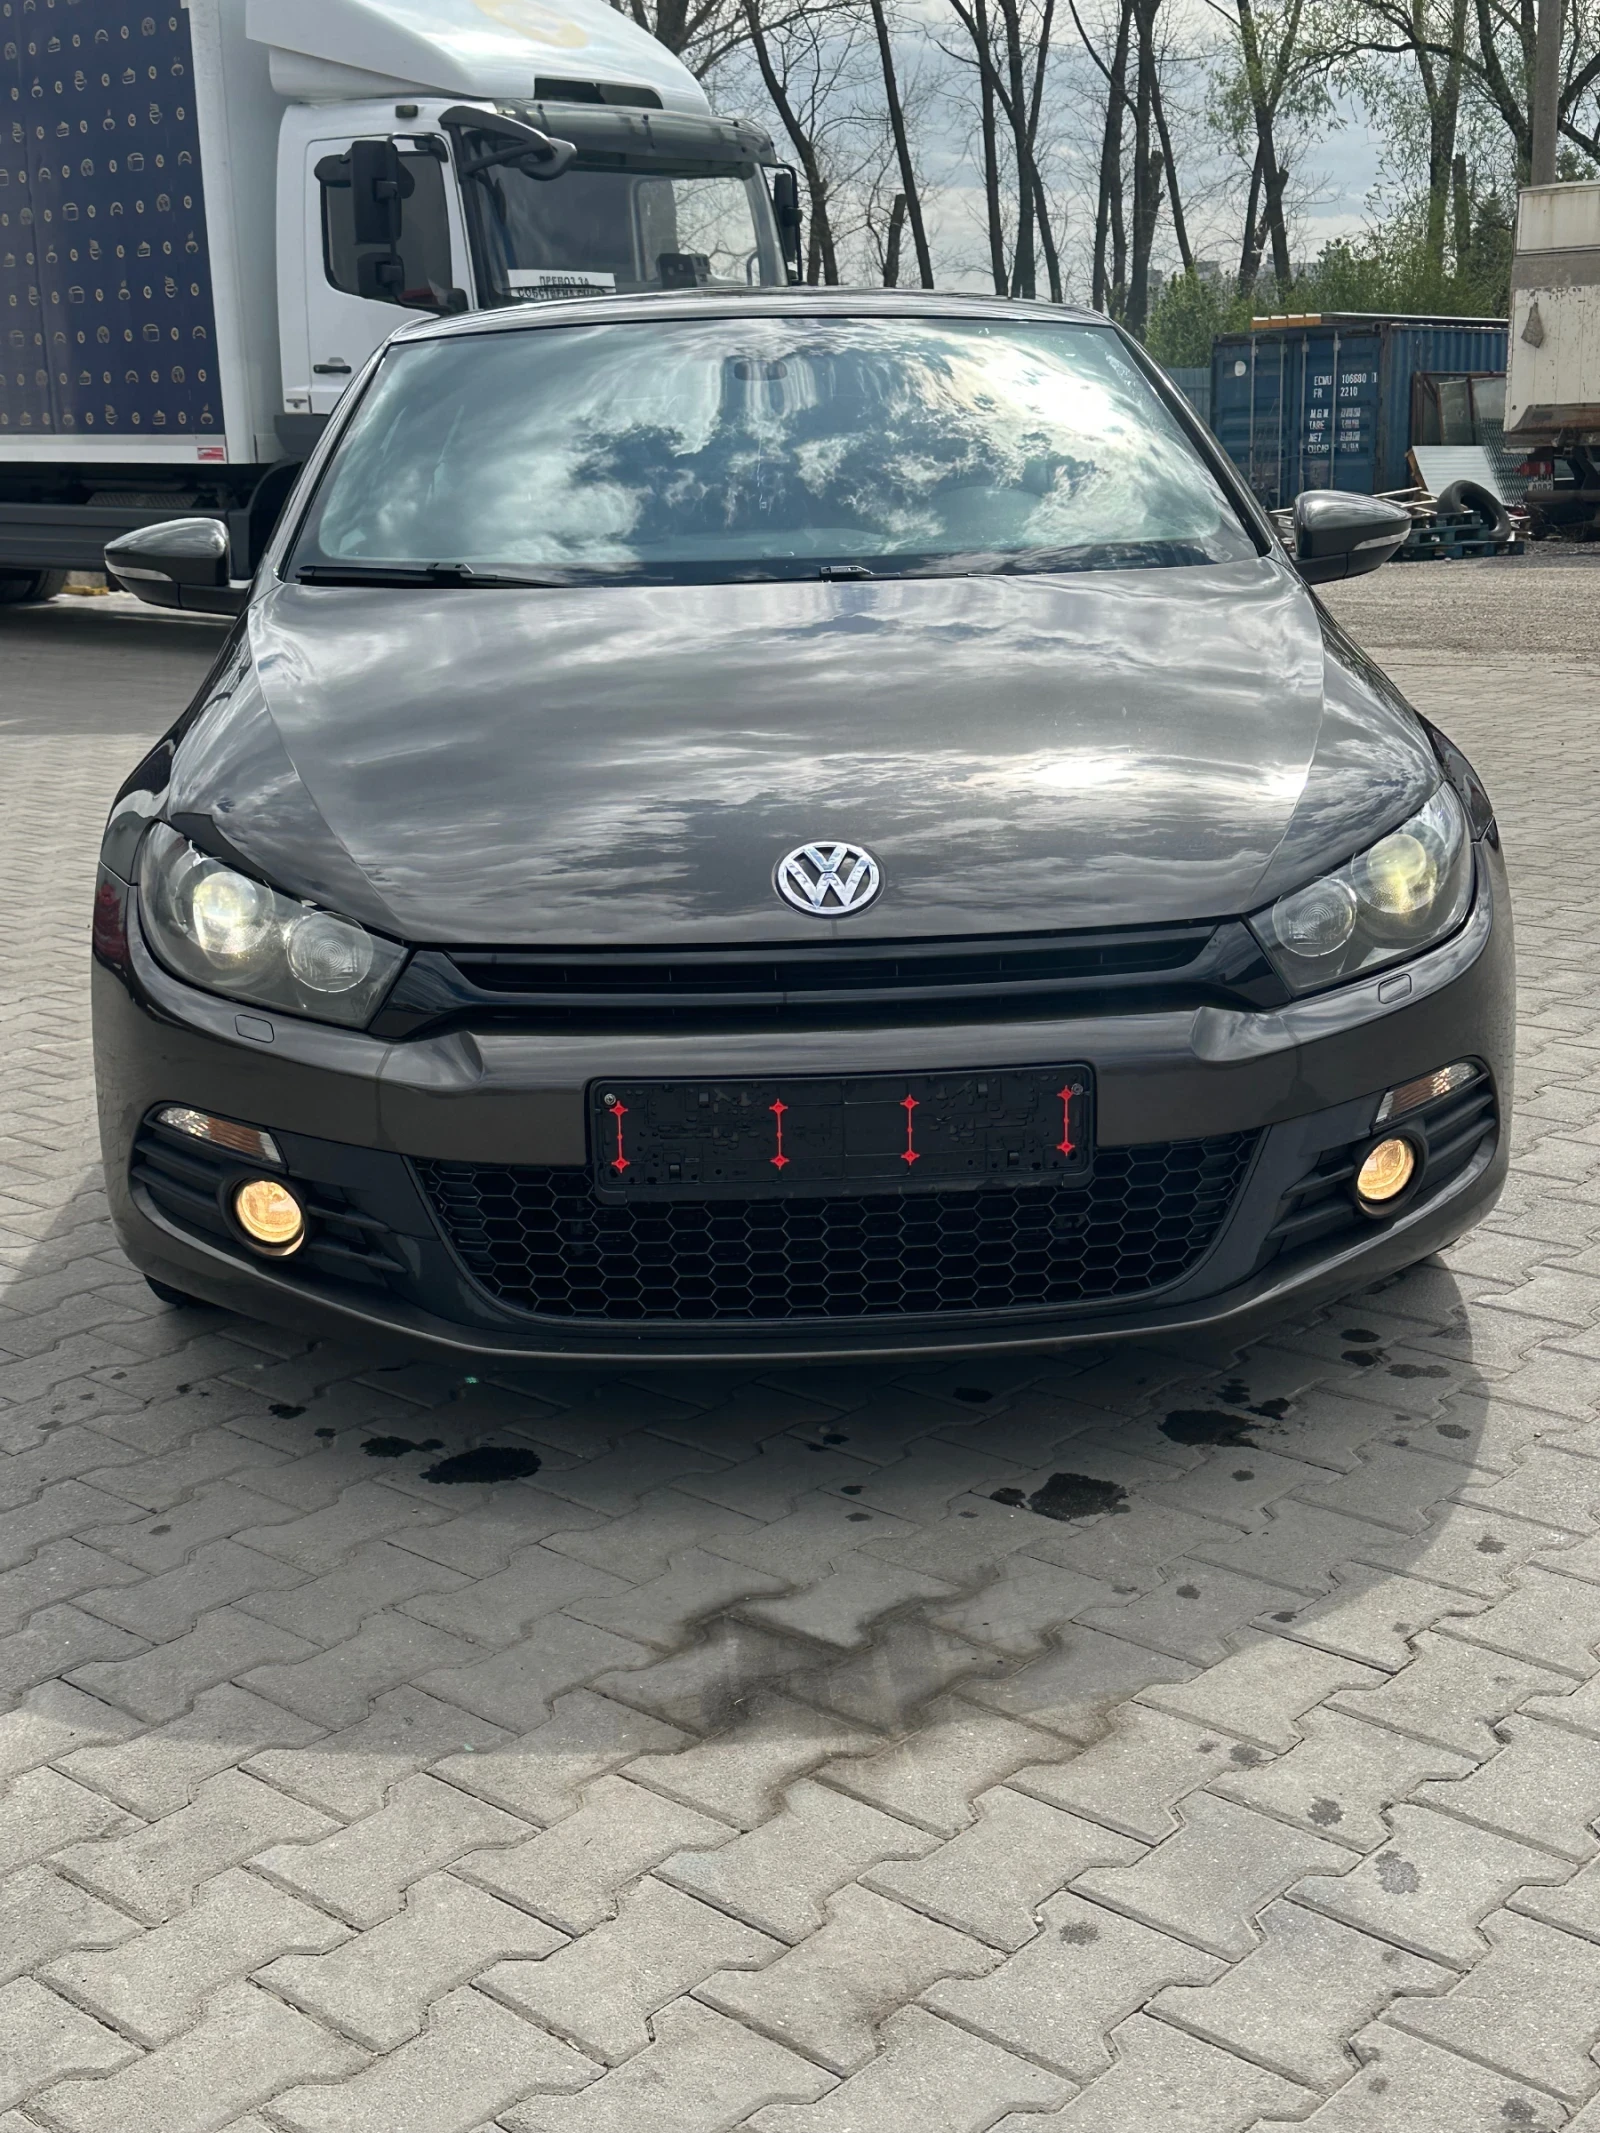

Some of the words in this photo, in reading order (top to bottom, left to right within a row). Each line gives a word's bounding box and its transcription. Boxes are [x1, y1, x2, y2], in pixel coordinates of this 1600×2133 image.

[1313, 388, 1323, 399] FR
[1340, 386, 1358, 397] 2210
[1308, 432, 1322, 443] NET
